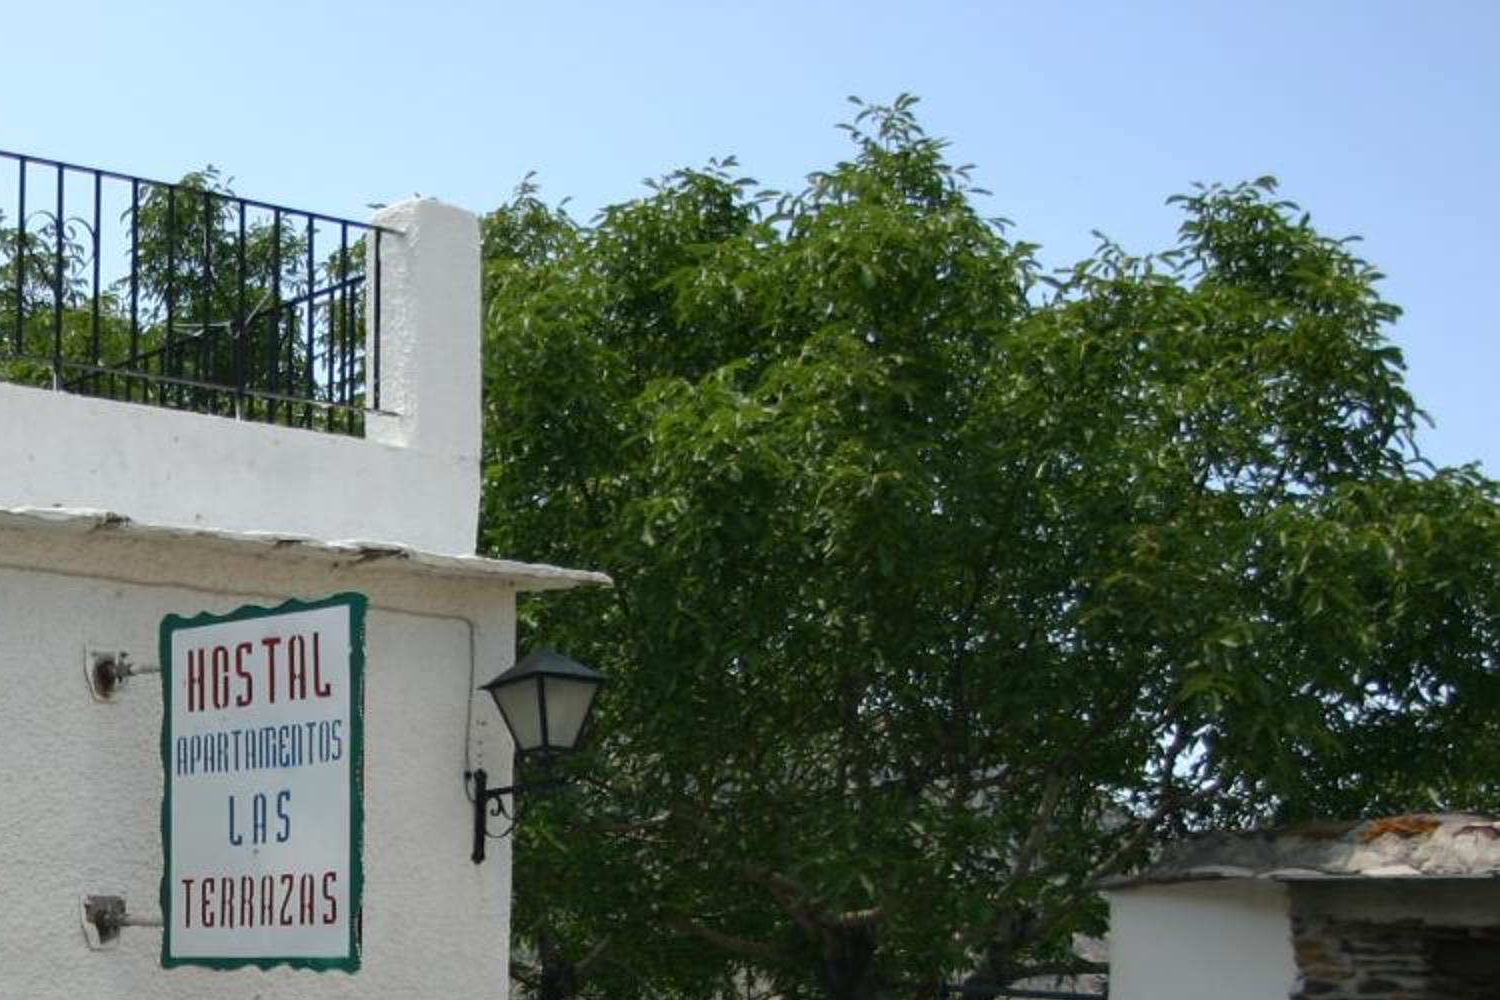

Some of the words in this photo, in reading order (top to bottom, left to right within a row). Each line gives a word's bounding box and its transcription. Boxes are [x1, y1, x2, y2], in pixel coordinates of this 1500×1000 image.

[187, 631, 331, 712] HOSTAL
[177, 719, 342, 776] APARTAMENTOS
[229, 790, 291, 846] LAS
[182, 871, 337, 928] TERRAZAS
